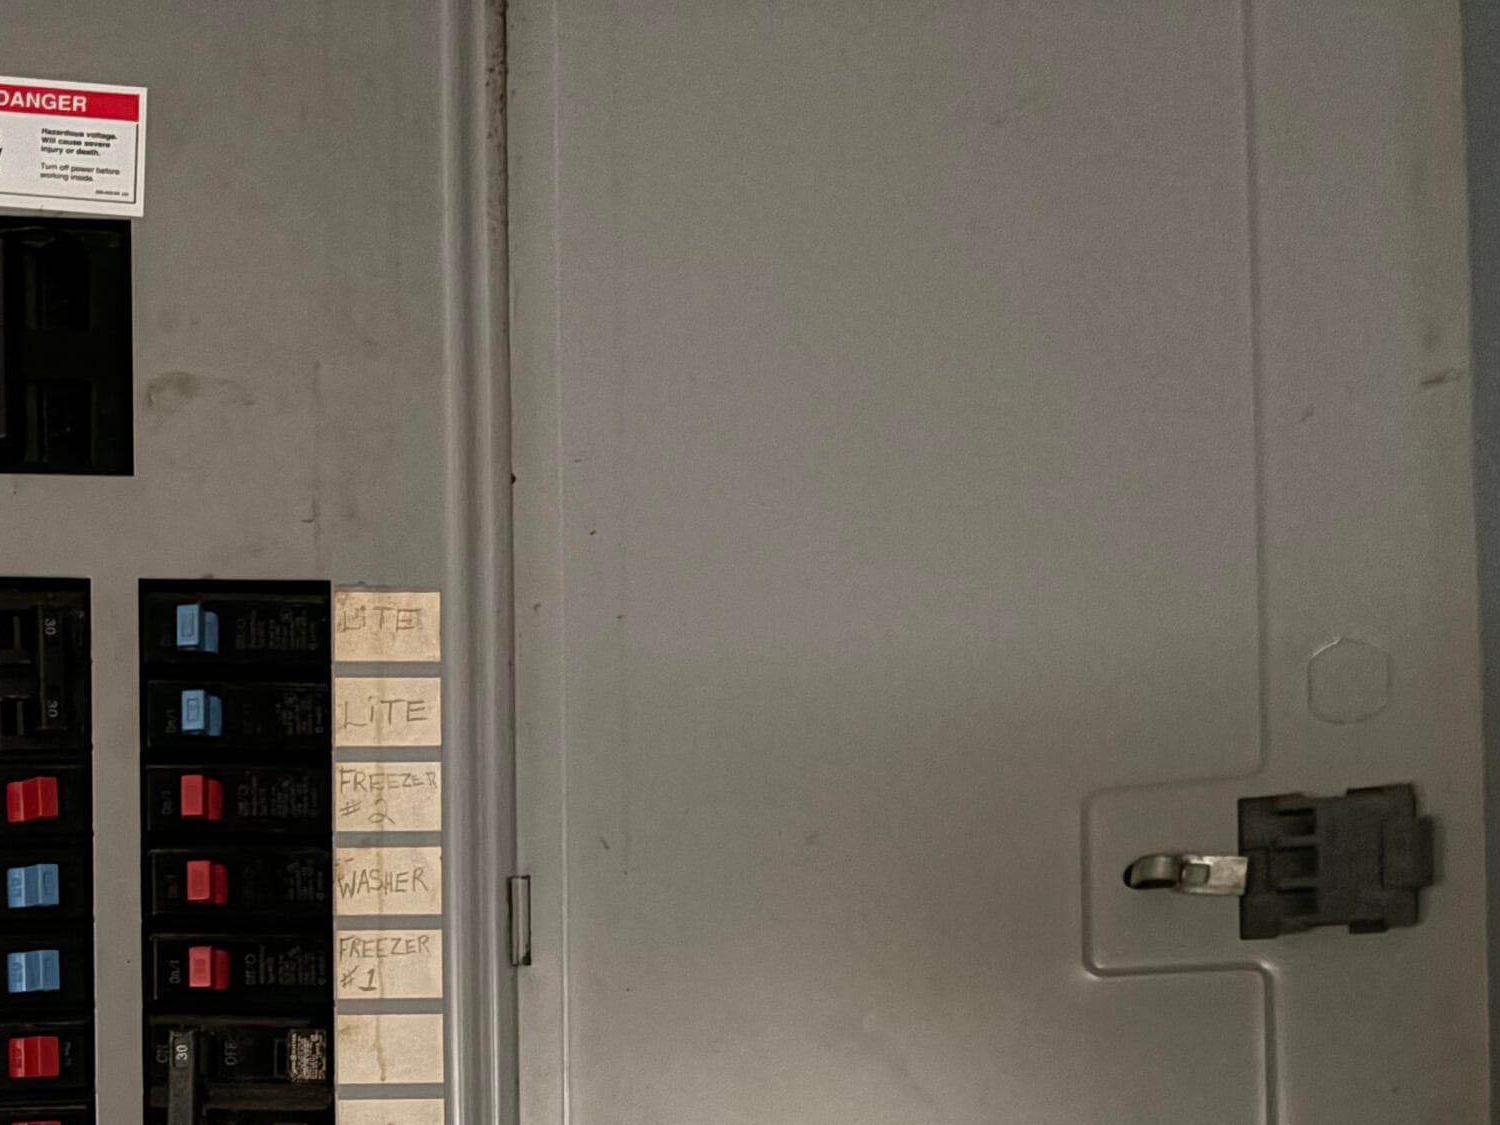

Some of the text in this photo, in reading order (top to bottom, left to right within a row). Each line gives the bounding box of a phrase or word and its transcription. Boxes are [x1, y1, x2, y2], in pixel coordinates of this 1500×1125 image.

[41, 162, 58, 170] Turn
[339, 767, 438, 794] FREEZER
[338, 867, 429, 899] WASHER
[339, 935, 430, 961] FREEZER
[176, 1045, 188, 1061] 30
